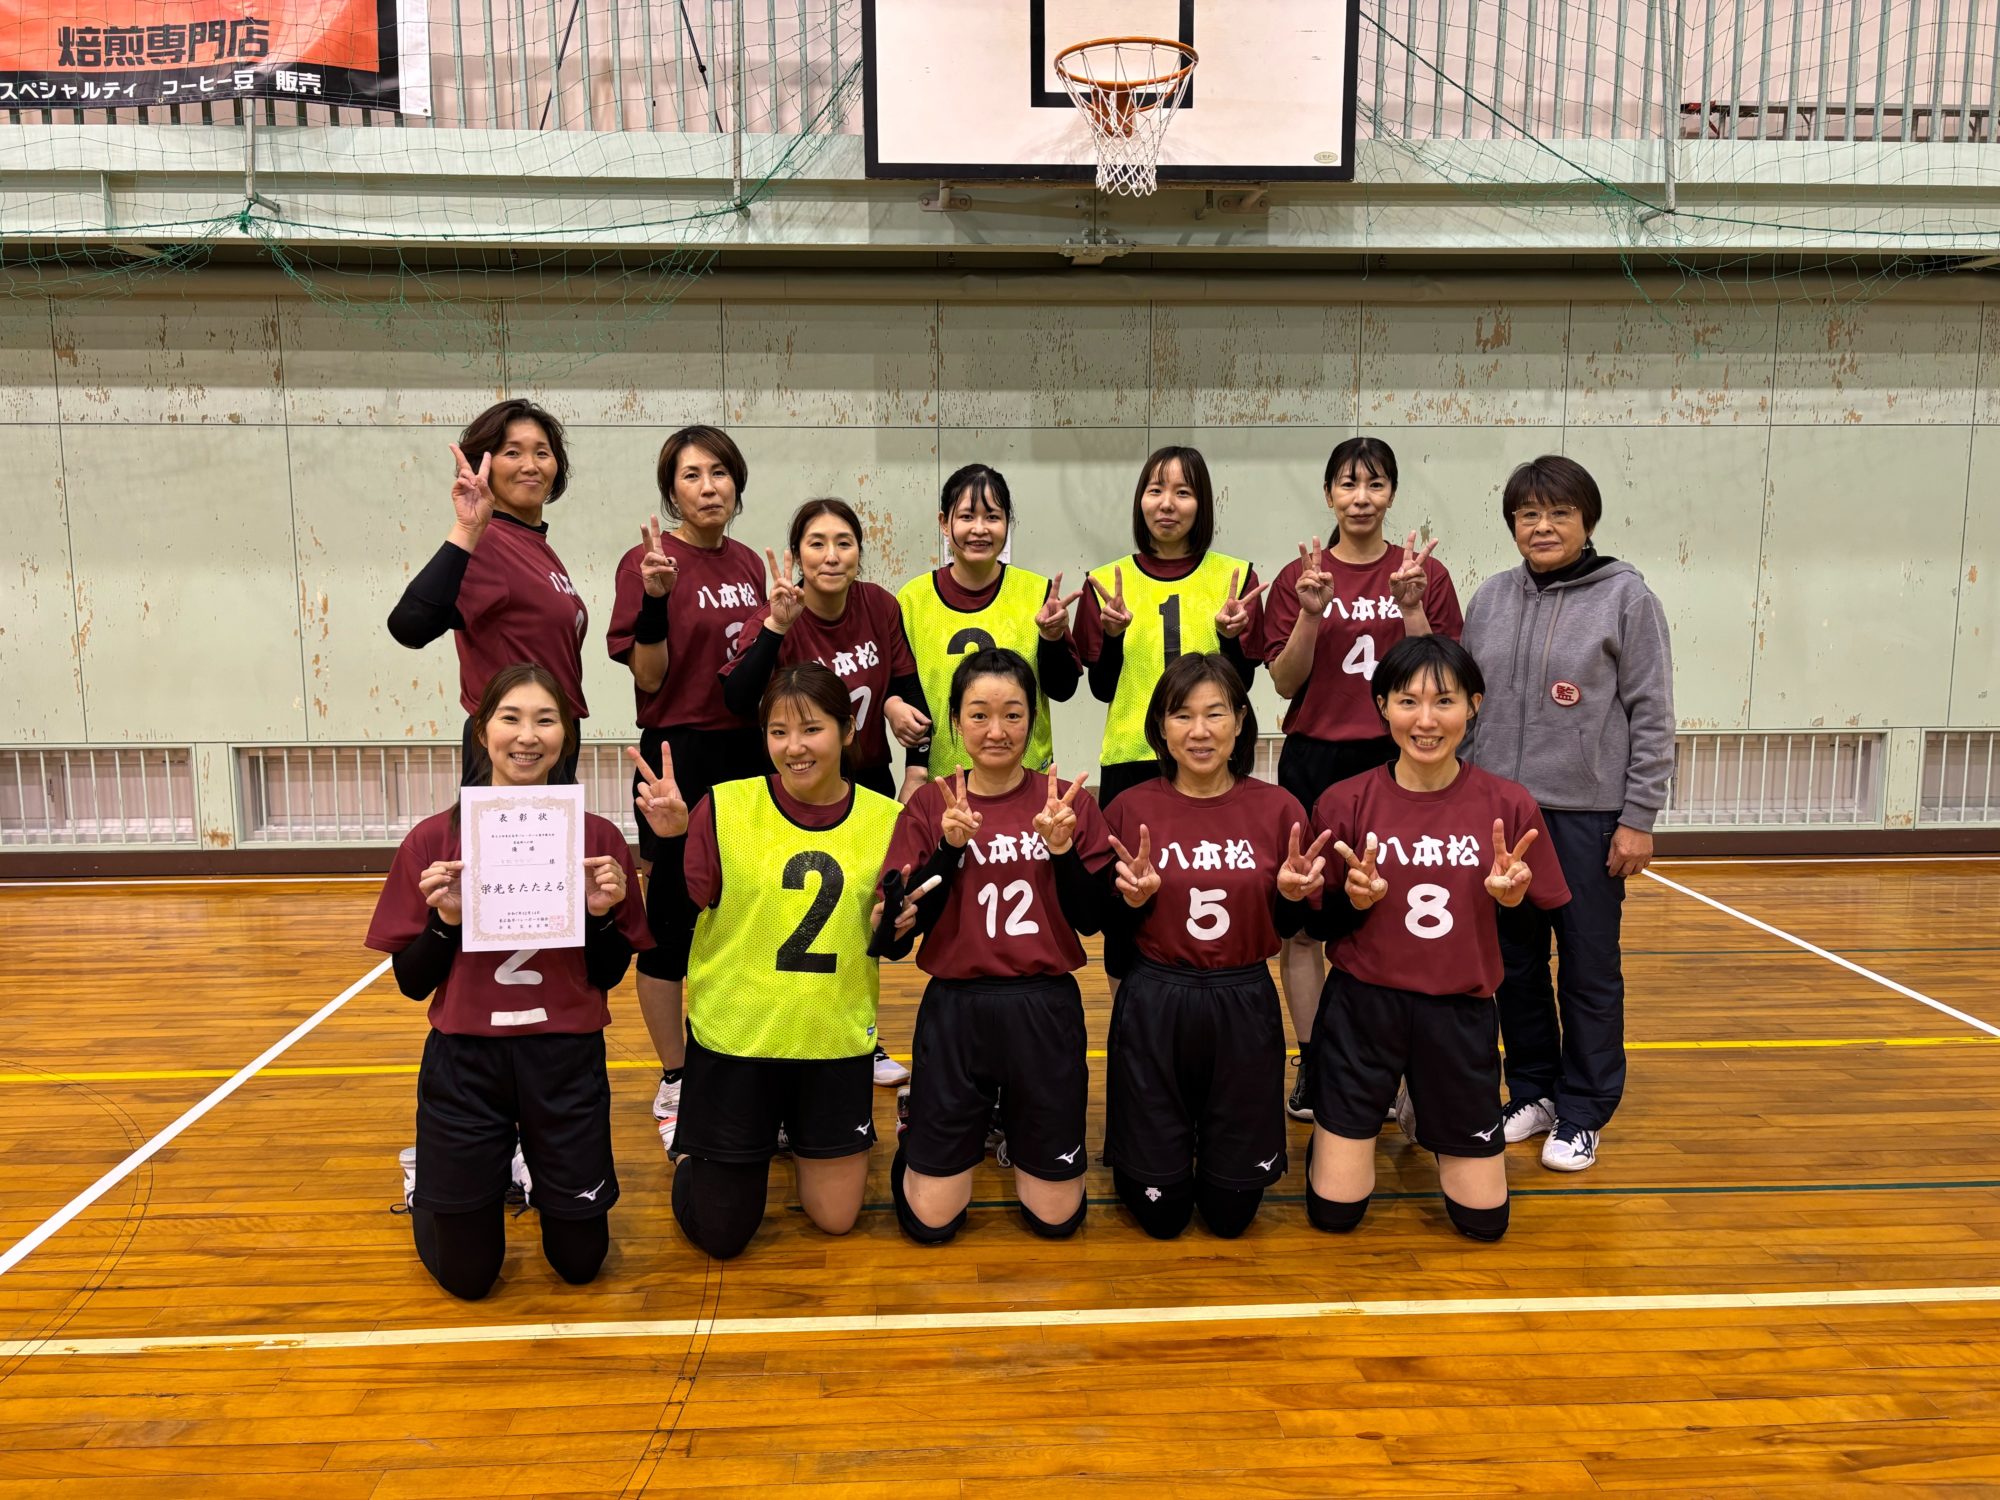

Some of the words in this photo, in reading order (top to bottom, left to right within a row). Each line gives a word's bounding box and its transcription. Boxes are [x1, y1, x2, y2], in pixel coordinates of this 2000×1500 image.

[57, 19, 270, 67] 焙煎専門店
[0, 81, 138, 100] スペシャルティ
[162, 70, 255, 95] コーヒー豆
[275, 70, 322, 95] 販売
[697, 582, 758, 609] 八本松
[1323, 597, 1404, 621] 八本松
[1159, 593, 1182, 669] 1
[1342, 634, 1380, 681] 4
[849, 685, 872, 732] 7
[1555, 684, 1575, 702] 監
[957, 831, 1050, 869] 八本松
[1158, 839, 1257, 871] 八本松
[1376, 834, 1480, 867] 八本松
[481, 881, 565, 895] 栄光をたたえる
[977, 879, 1040, 939] 12
[775, 850, 845, 974] 2
[1186, 887, 1230, 941] 5
[1404, 883, 1454, 939] 8
